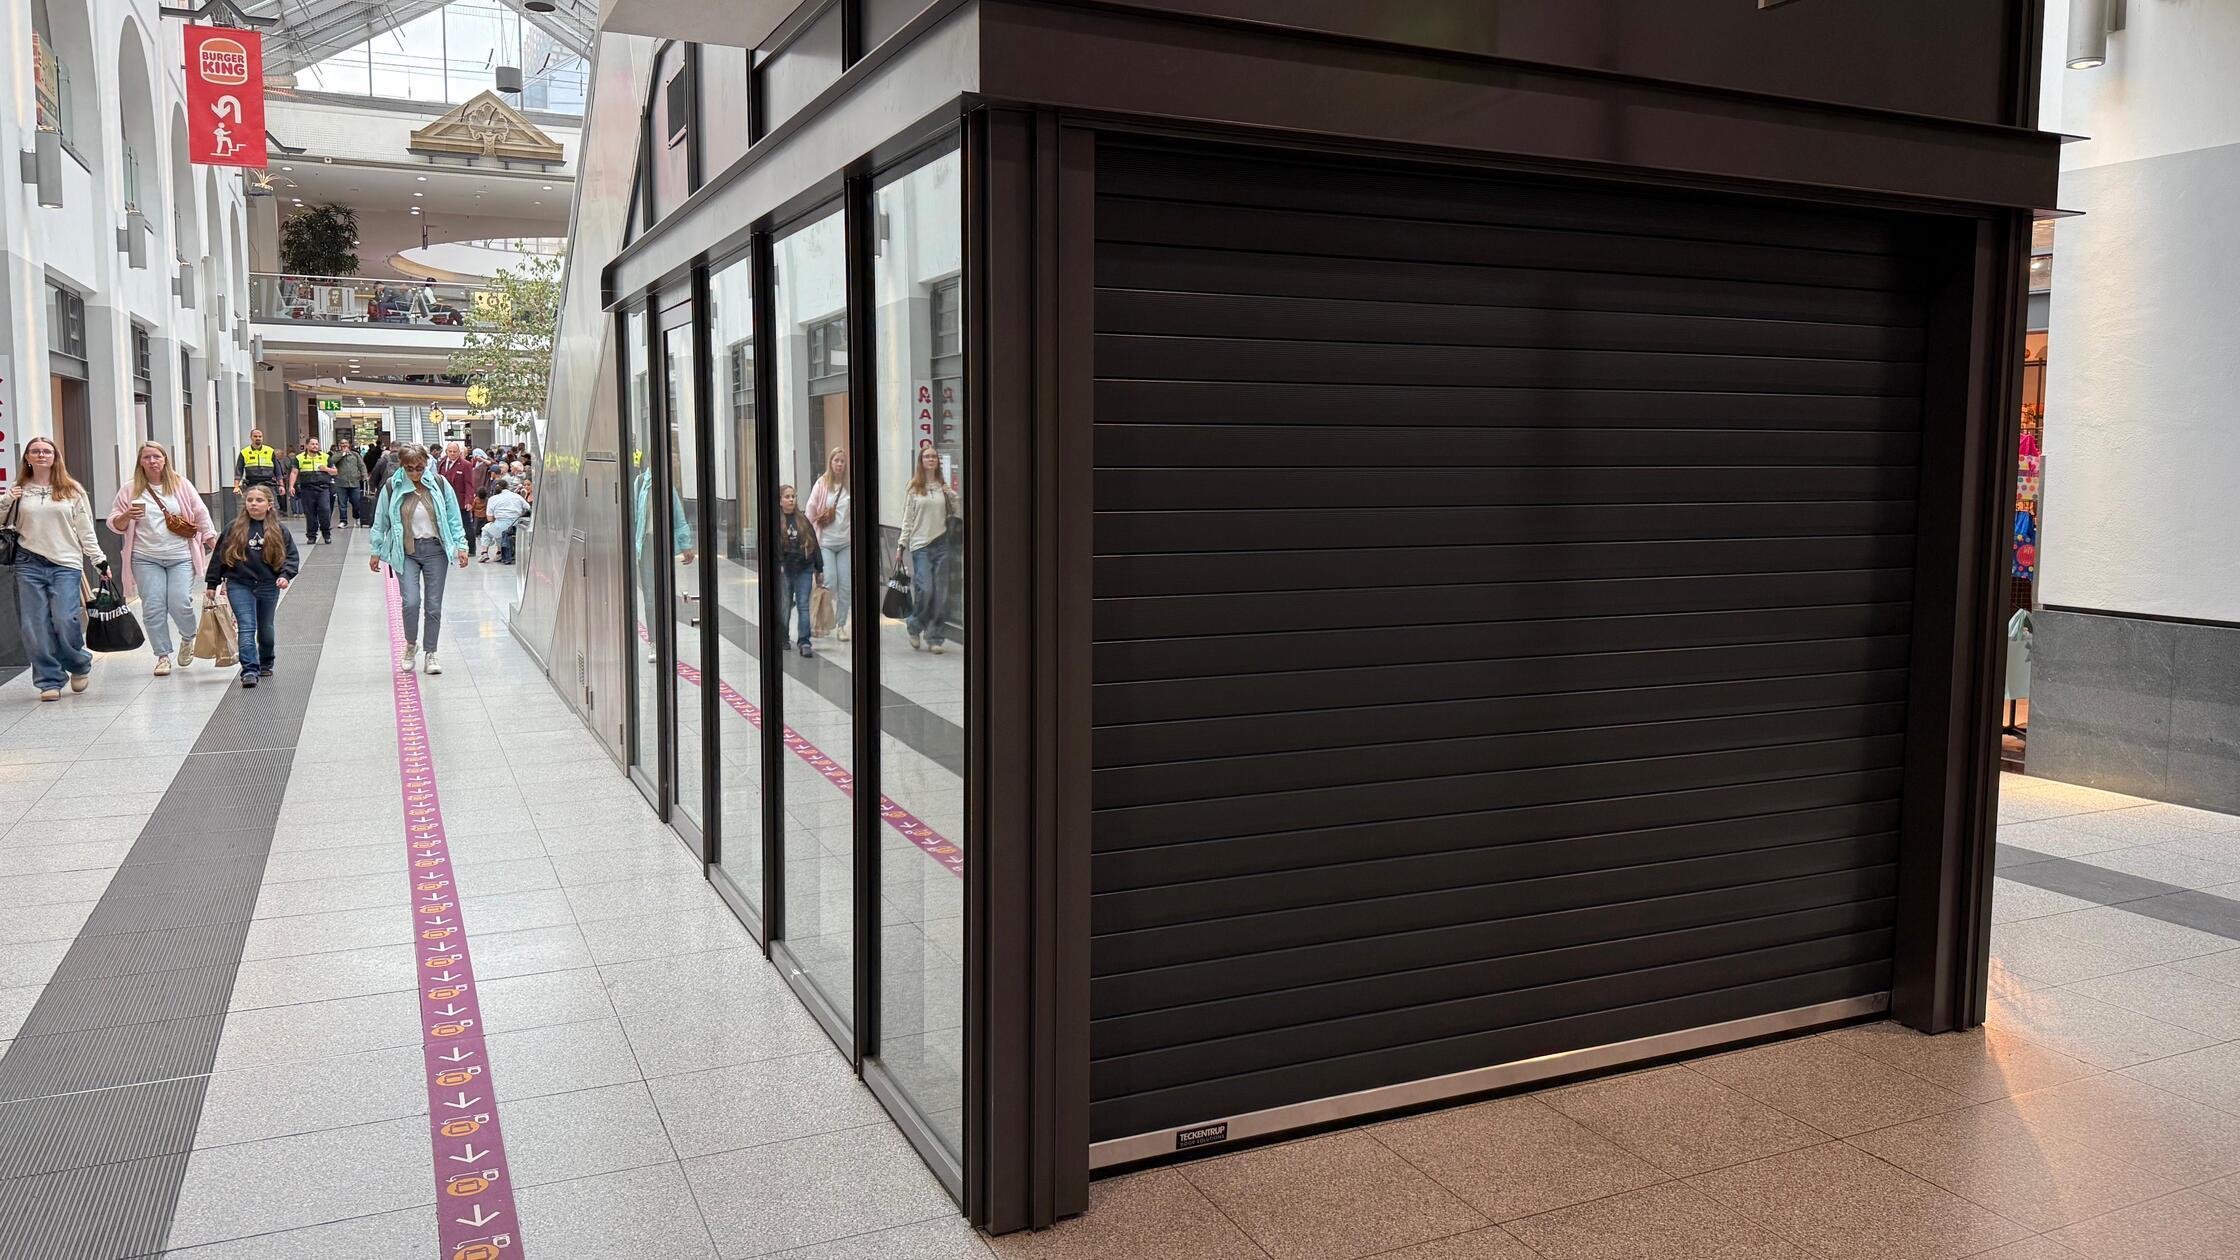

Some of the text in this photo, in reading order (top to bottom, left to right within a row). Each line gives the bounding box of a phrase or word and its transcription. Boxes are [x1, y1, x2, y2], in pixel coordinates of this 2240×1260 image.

[202, 52, 245, 63] BURGER
[202, 60, 246, 75] KING
[1180, 1125, 1225, 1142] TECKENTRUP
[1196, 1134, 1225, 1144] SOLUTIONS
